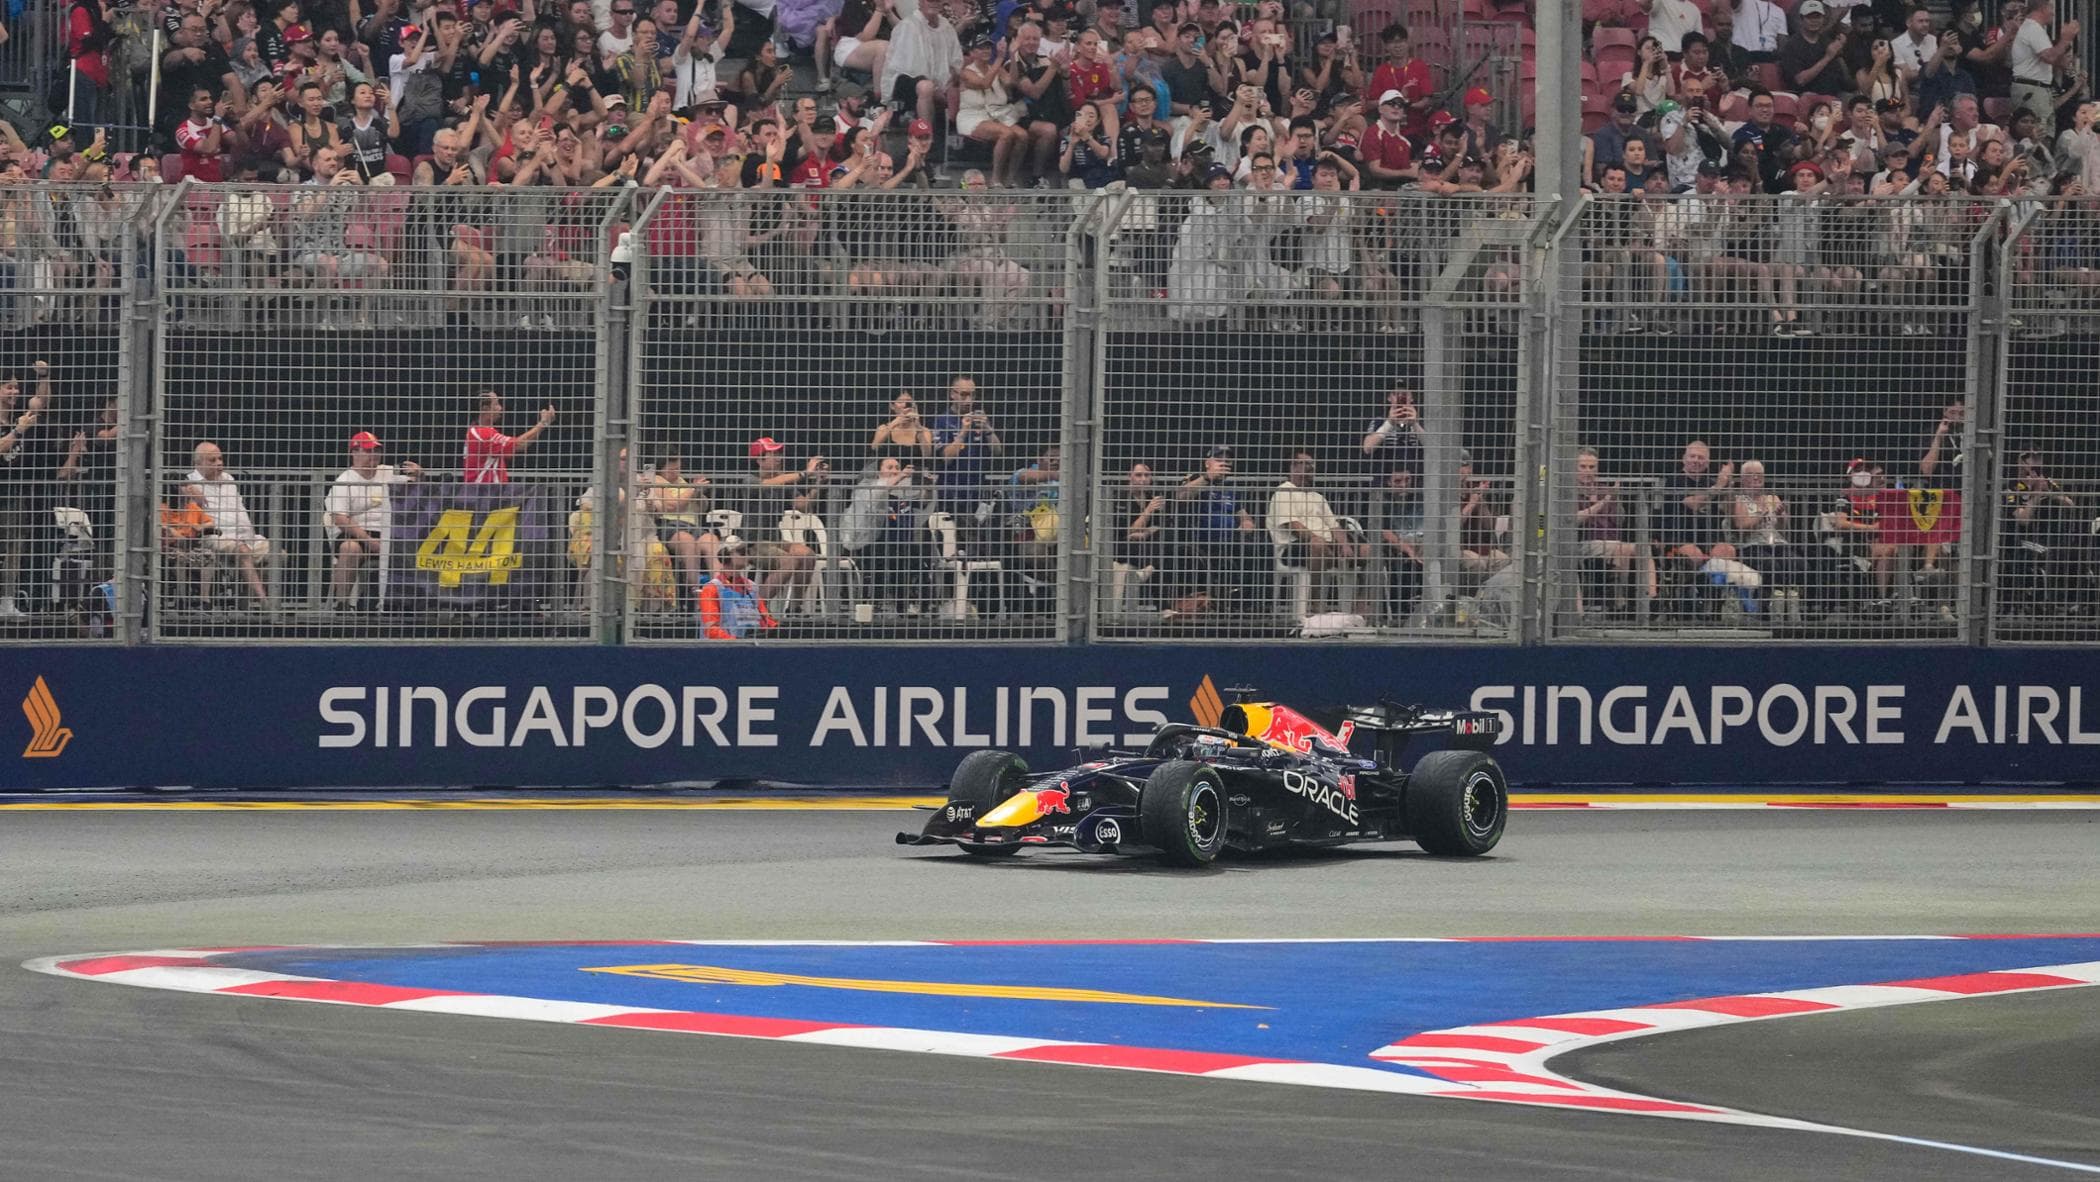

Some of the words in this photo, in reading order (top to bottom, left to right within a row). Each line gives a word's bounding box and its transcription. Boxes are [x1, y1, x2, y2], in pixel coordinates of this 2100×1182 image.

[416, 507, 523, 588] 44
[419, 557, 453, 569] LEWIS
[457, 556, 518, 570] HAMILTON
[318, 684, 779, 748] SINGAPORE
[809, 686, 1170, 747] AIRLINES
[1470, 684, 1905, 747] SINGAPORE
[1934, 685, 2100, 745] AIRL
[1456, 718, 1485, 735] Mobil
[1283, 770, 1359, 826] ORACLE
[956, 806, 973, 820] AT&T
[1053, 826, 1076, 834] VIS
[1099, 826, 1117, 838] Esso
